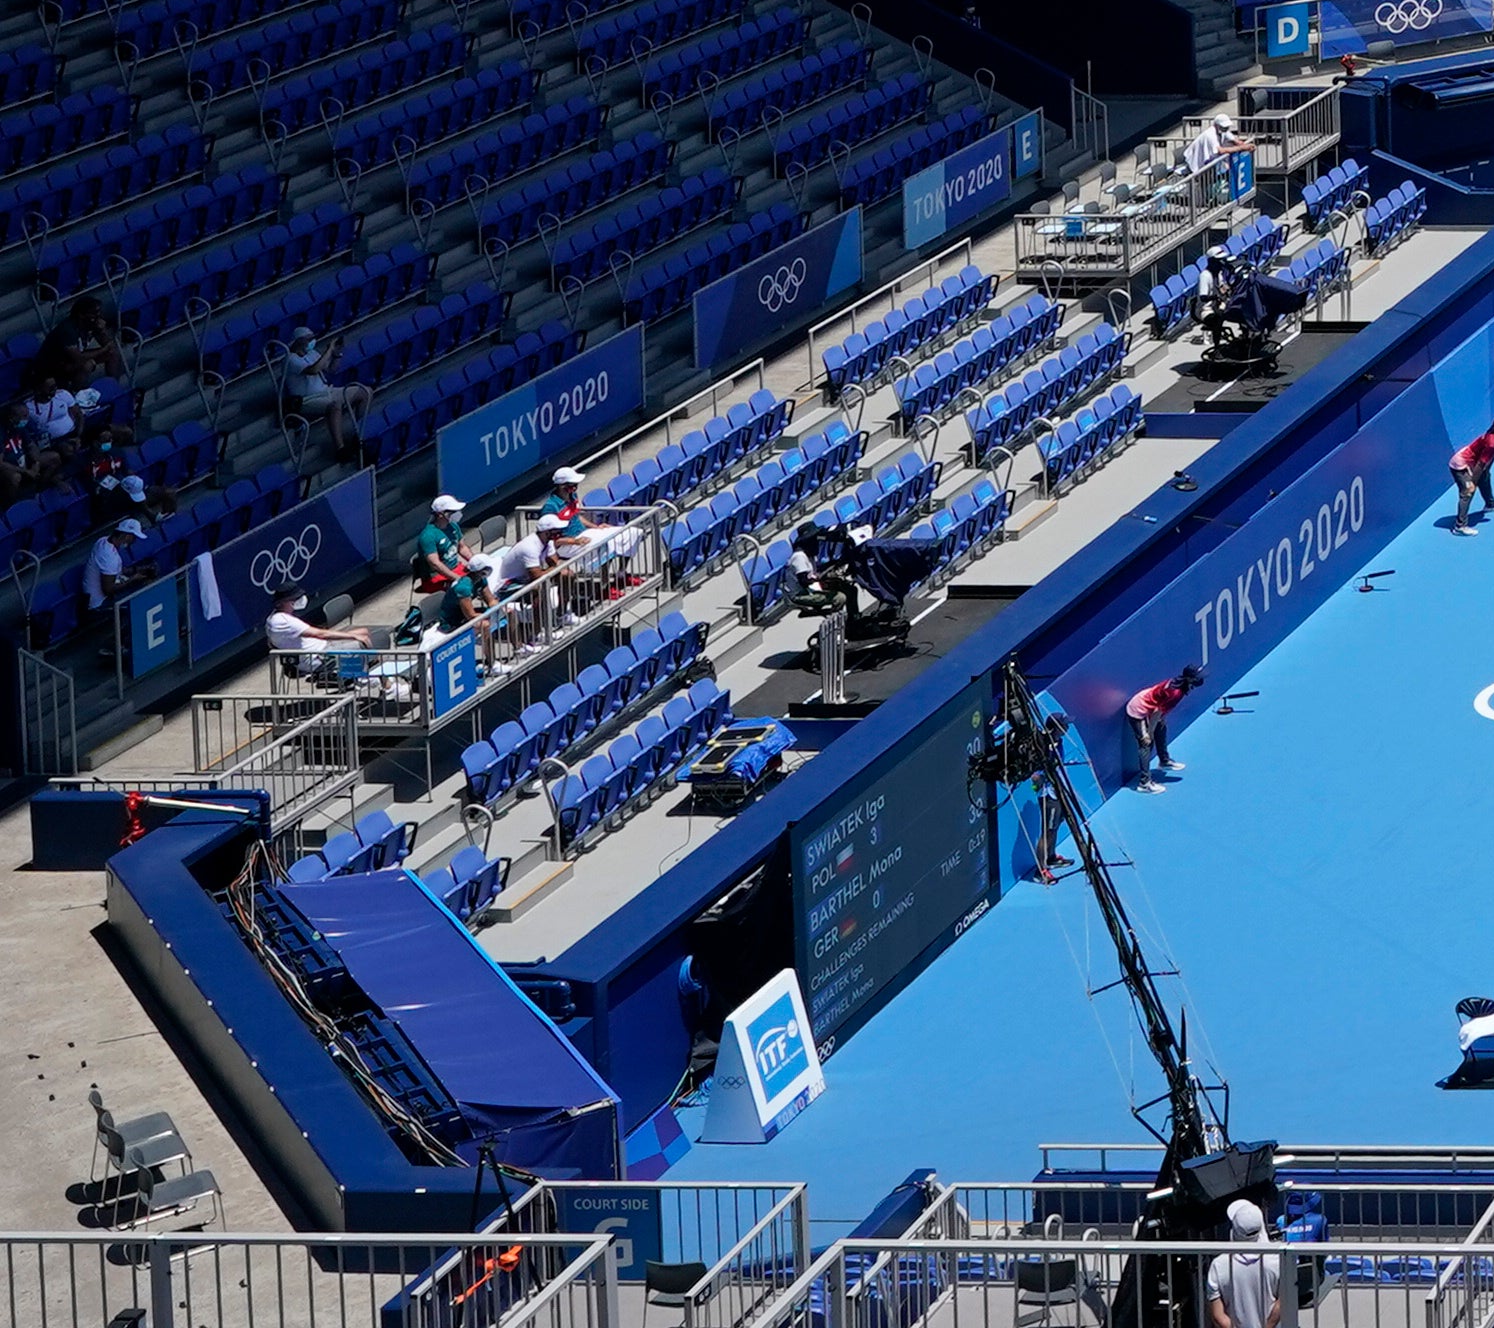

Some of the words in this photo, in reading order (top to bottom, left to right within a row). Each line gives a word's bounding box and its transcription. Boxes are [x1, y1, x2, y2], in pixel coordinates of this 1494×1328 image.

[1280, 18, 1298, 44] D
[1022, 130, 1032, 161] E
[914, 178, 964, 226] TOKYO
[967, 156, 1004, 200] 2020
[480, 401, 552, 467] TOKYO
[556, 370, 610, 429] 2020
[1194, 538, 1292, 664] TOKYO
[1298, 475, 1365, 578] 2020
[146, 604, 165, 649] E
[449, 656, 464, 697] E
[807, 808, 863, 866] SWIATEK
[865, 794, 885, 822] Iga
[870, 827, 877, 845] 3
[811, 874, 866, 932] BARTHEL
[869, 846, 902, 883] Mona
[812, 863, 836, 893] POL
[872, 890, 879, 908] 0
[963, 898, 990, 928] OMEGA
[814, 927, 839, 959] GER
[811, 936, 868, 991] CHALLENGES
[760, 1035, 787, 1074] ITF
[574, 1197, 618, 1211] COURT
[620, 1197, 649, 1211] SIDE
